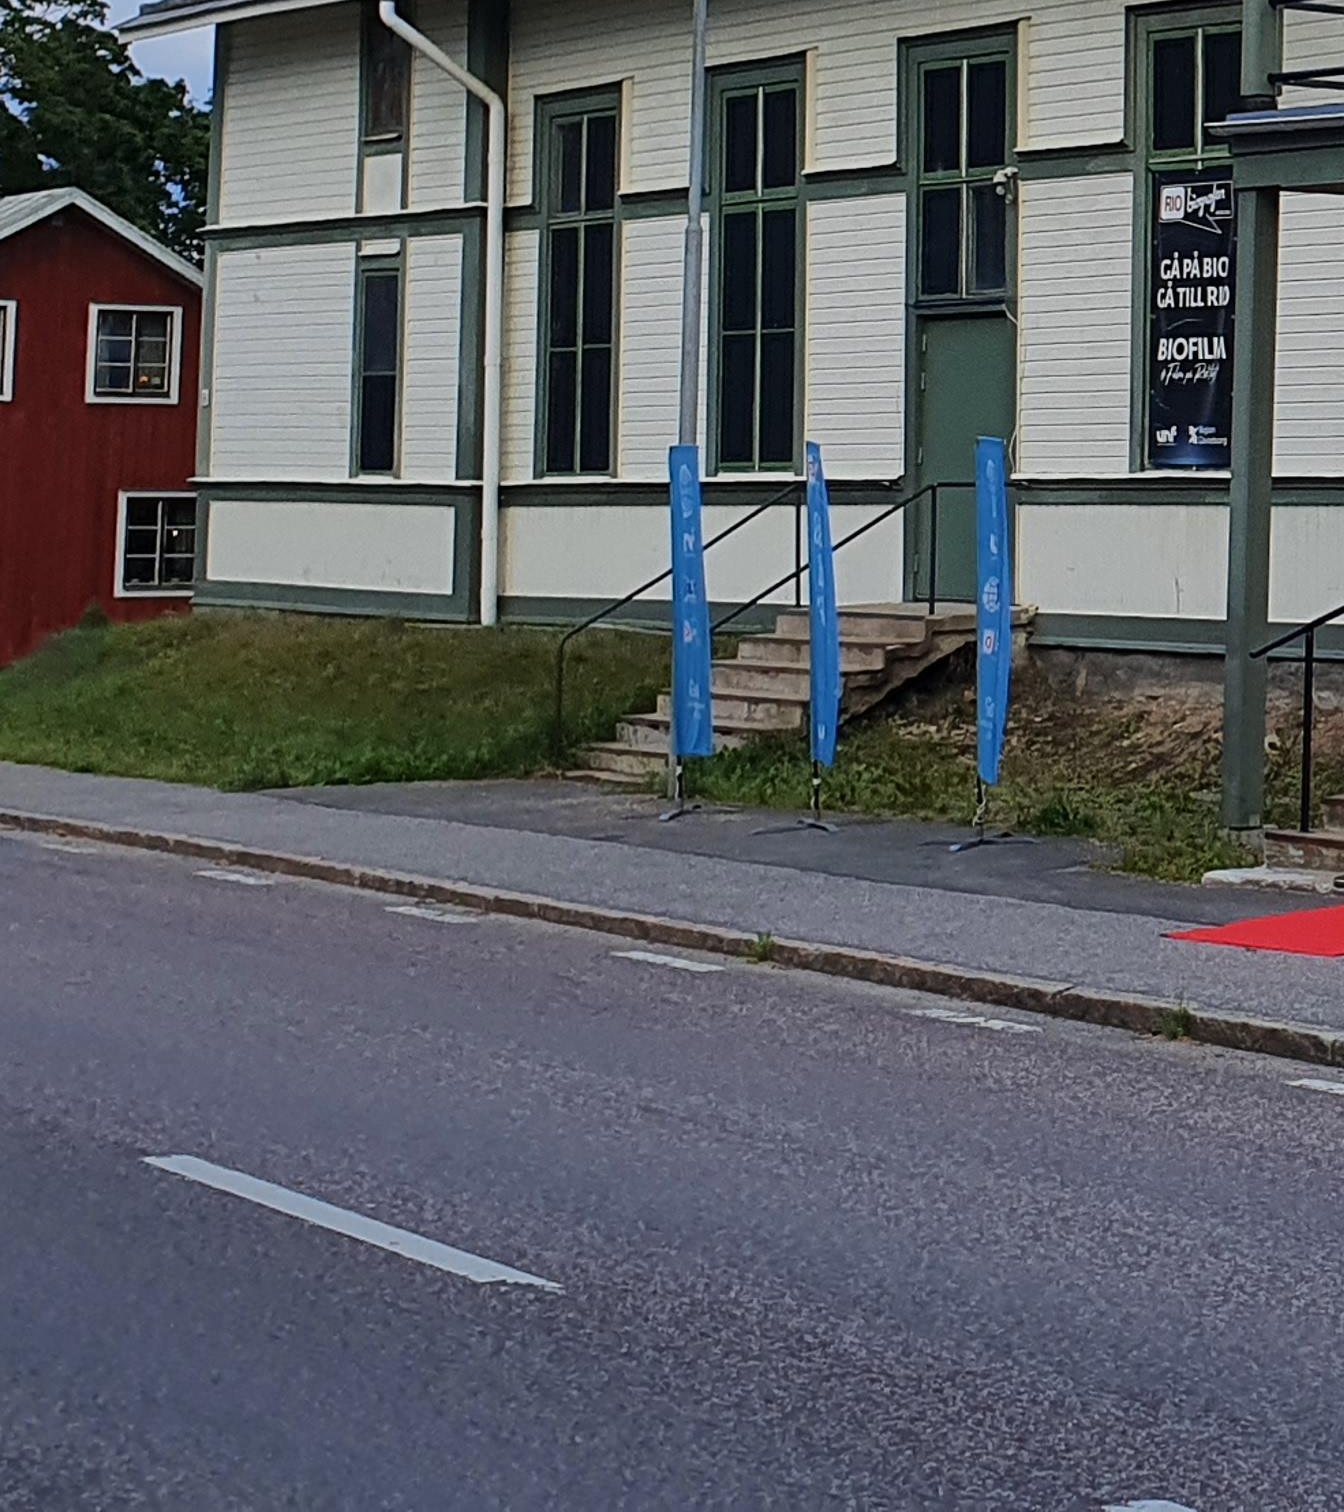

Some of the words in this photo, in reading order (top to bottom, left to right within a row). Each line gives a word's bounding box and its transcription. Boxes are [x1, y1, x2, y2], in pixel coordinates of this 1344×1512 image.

[1164, 195, 1183, 212] RIO
[1161, 251, 1180, 280] GÅ
[1182, 250, 1201, 279] PÅ
[1202, 256, 1229, 278] BIO
[1157, 280, 1175, 308] GÅ
[1176, 287, 1204, 308] TILL
